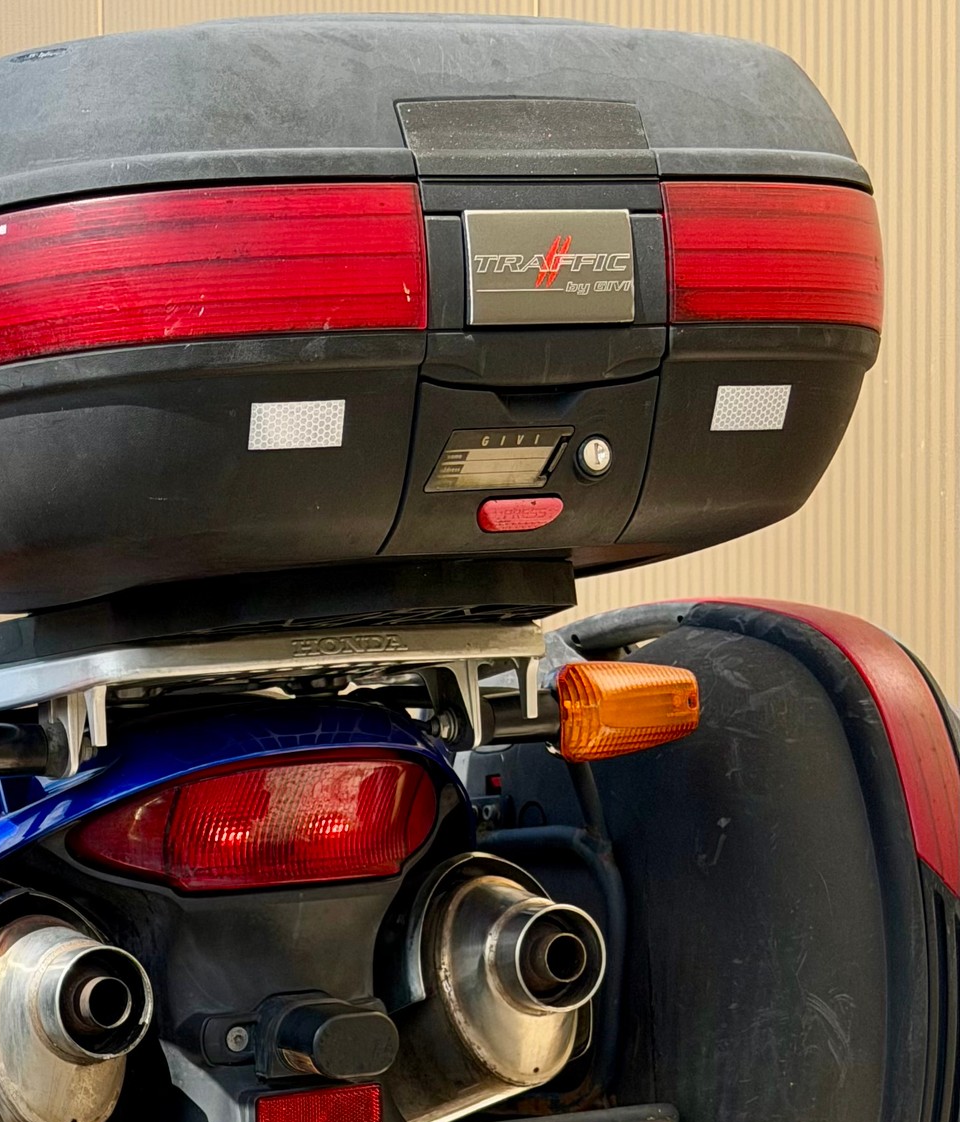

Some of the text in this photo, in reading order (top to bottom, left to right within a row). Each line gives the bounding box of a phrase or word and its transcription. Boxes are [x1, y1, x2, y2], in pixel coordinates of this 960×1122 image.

[473, 252, 631, 274] TRAFFIC
[565, 279, 634, 296] by GIVI
[481, 433, 541, 447] GIVI
[291, 633, 409, 657] HONDA
